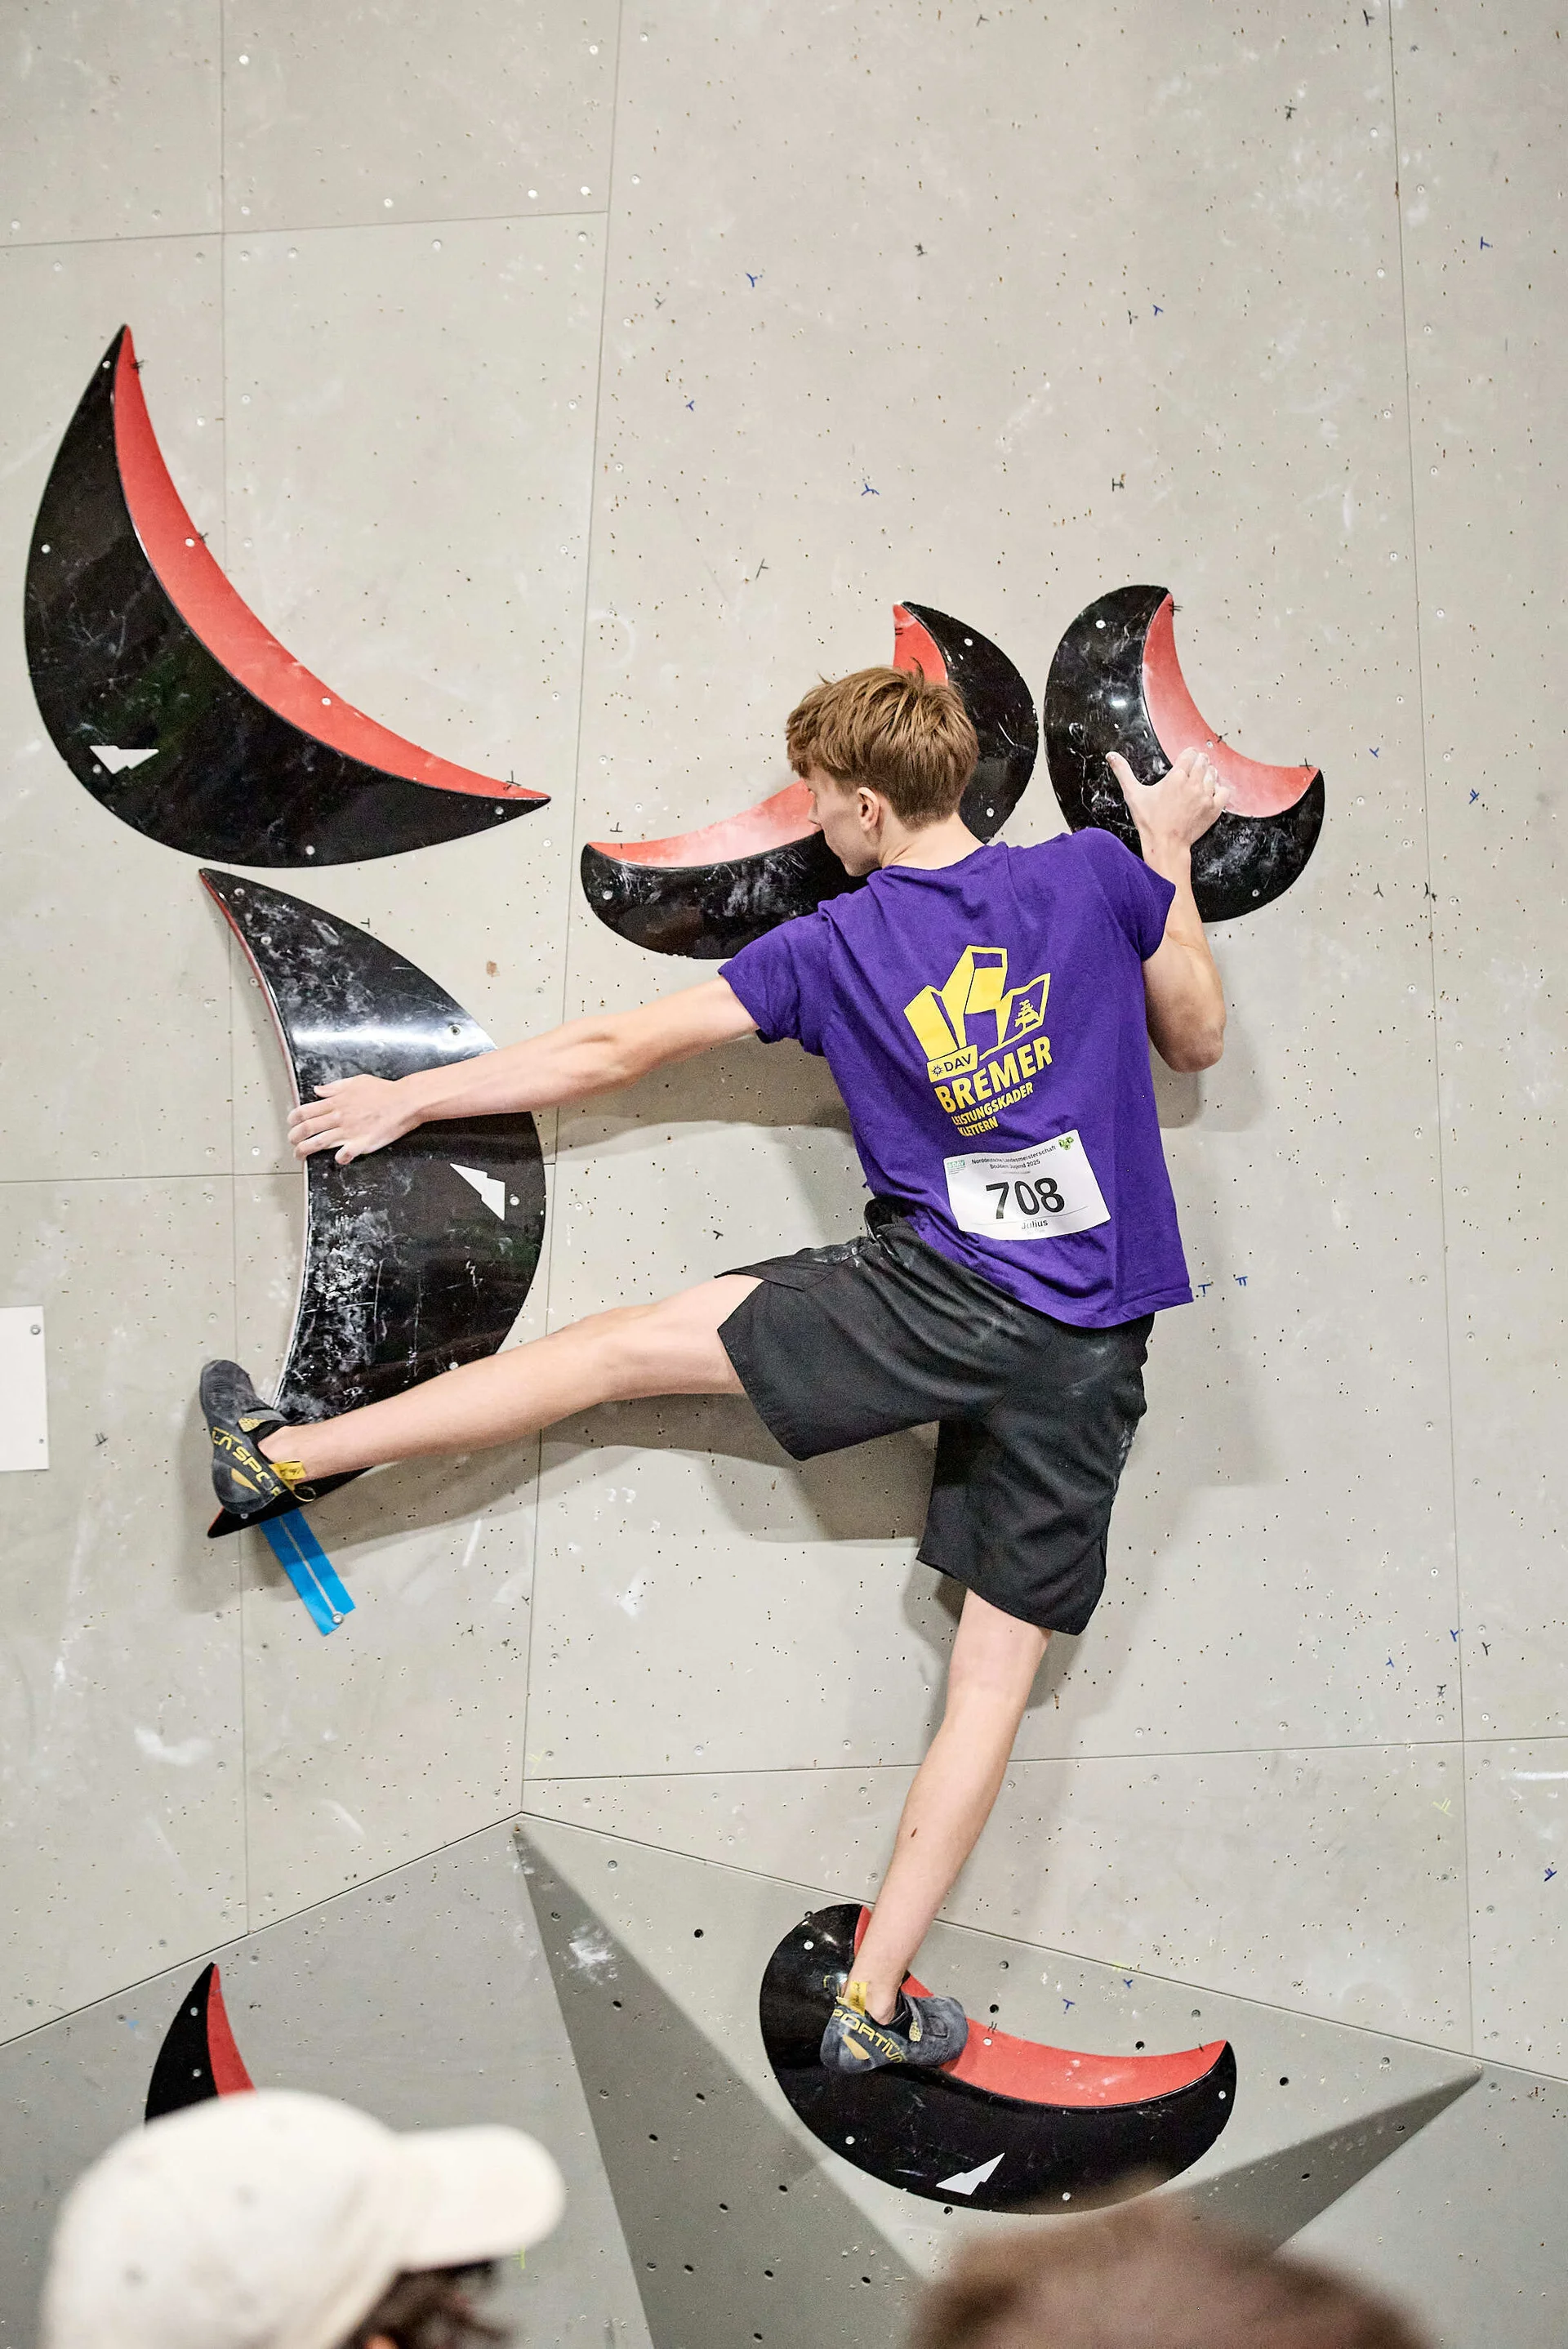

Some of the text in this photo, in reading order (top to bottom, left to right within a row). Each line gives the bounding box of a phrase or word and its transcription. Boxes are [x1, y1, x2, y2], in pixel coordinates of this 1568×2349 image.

[943, 1054, 971, 1072] DAV
[933, 1036, 1053, 1113] BREMER
[1027, 1159, 1040, 1167] 2025
[986, 1177, 1065, 1219] 708
[1022, 1219, 1049, 1229] Julius
